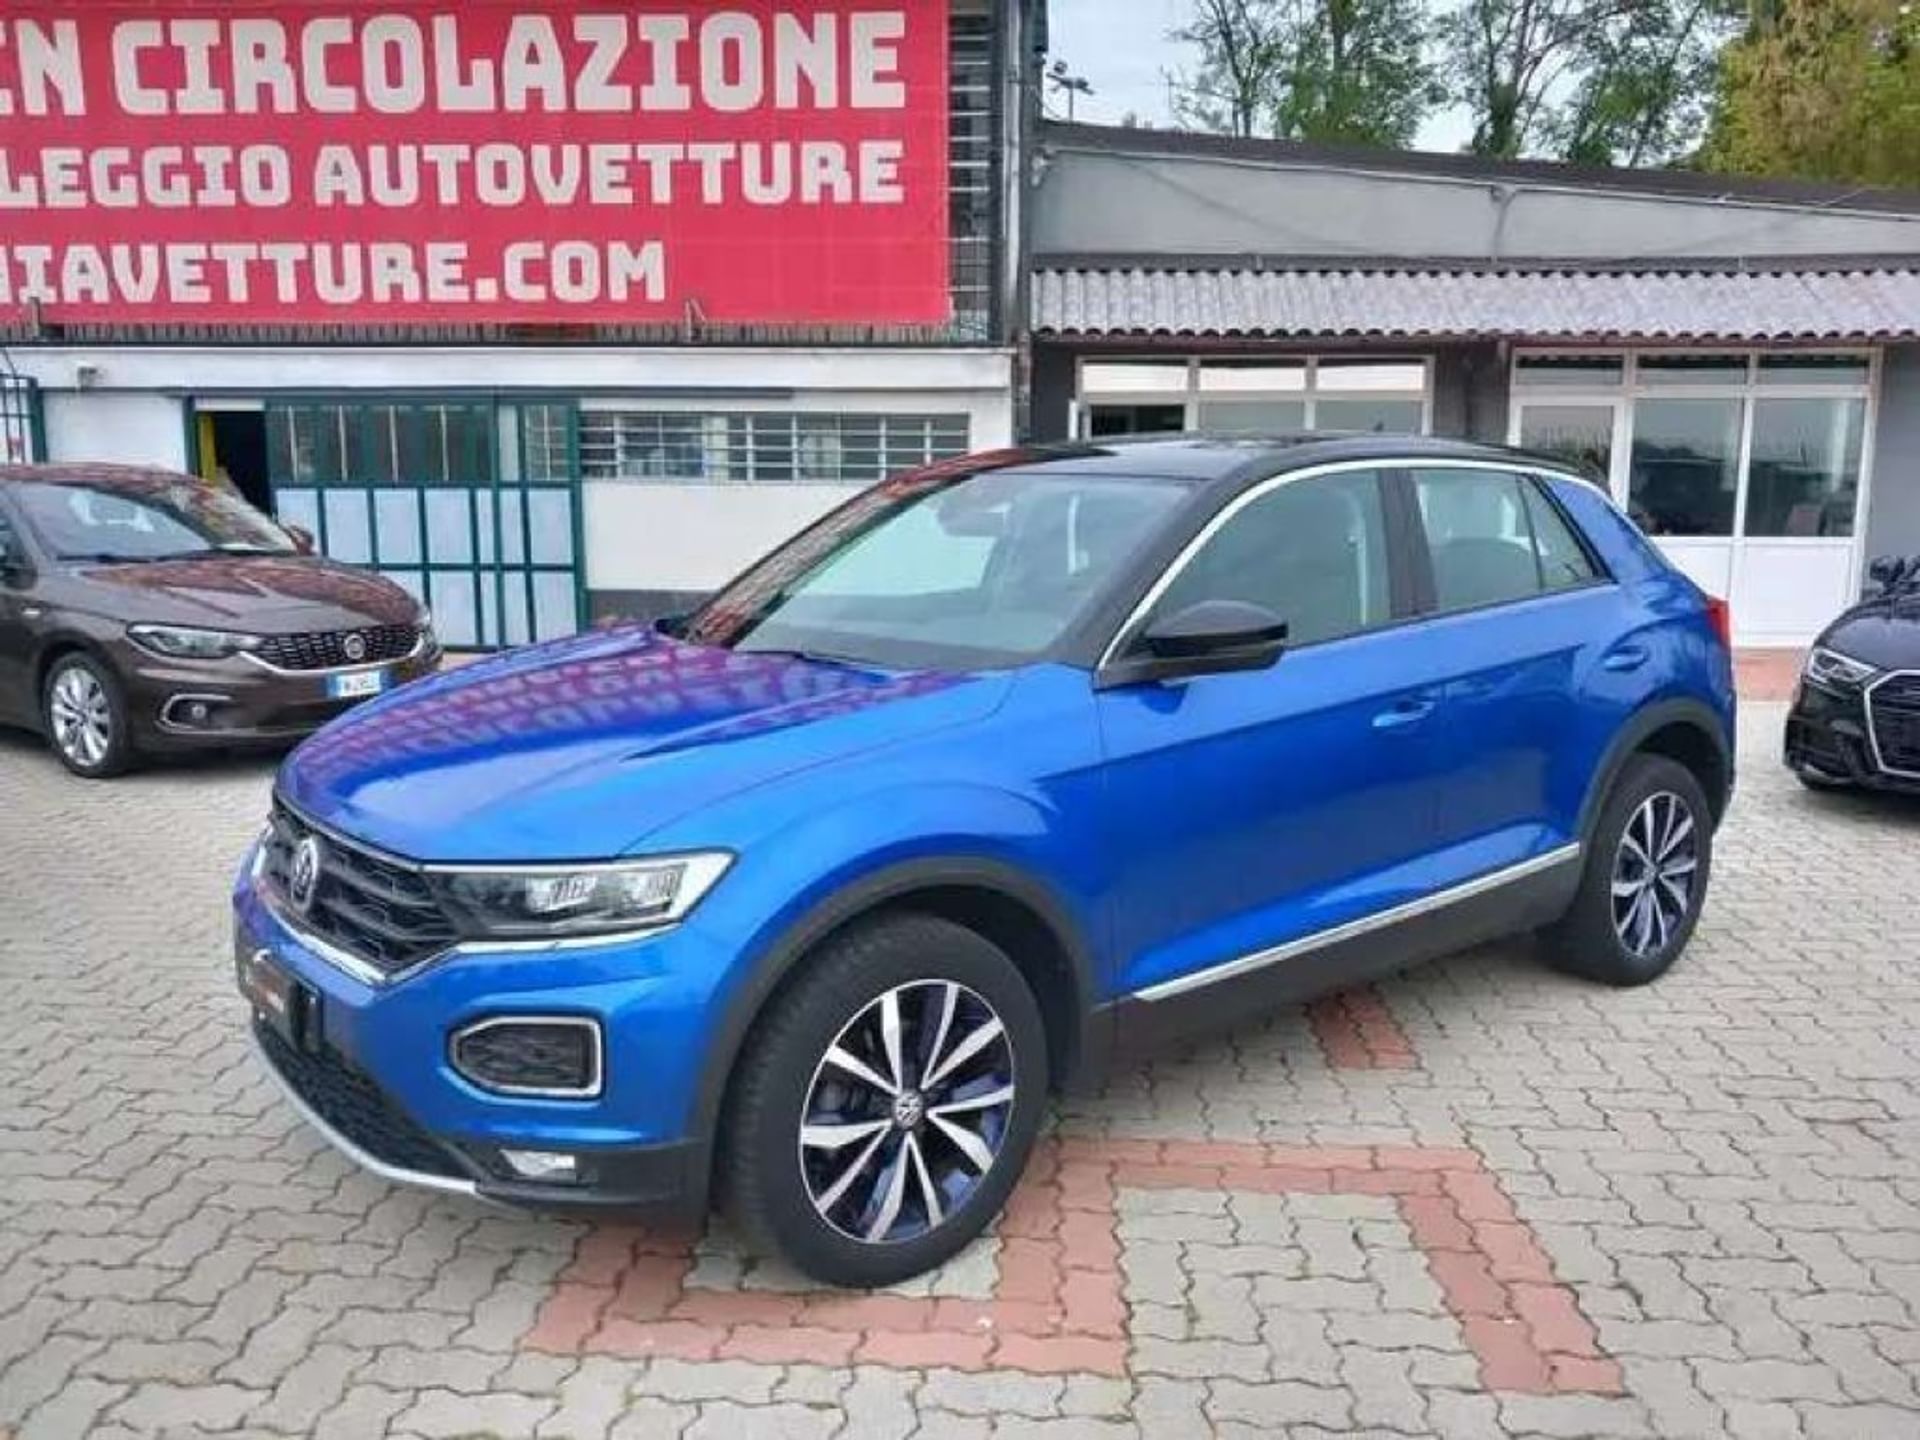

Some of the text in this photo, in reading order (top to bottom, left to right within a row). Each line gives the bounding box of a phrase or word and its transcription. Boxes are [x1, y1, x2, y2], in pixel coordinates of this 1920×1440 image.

[111, 12, 905, 115] CIRCOLAZIONE
[314, 140, 904, 206] AUTOVETTURE
[0, 241, 665, 303] IAVETTURE.COM
